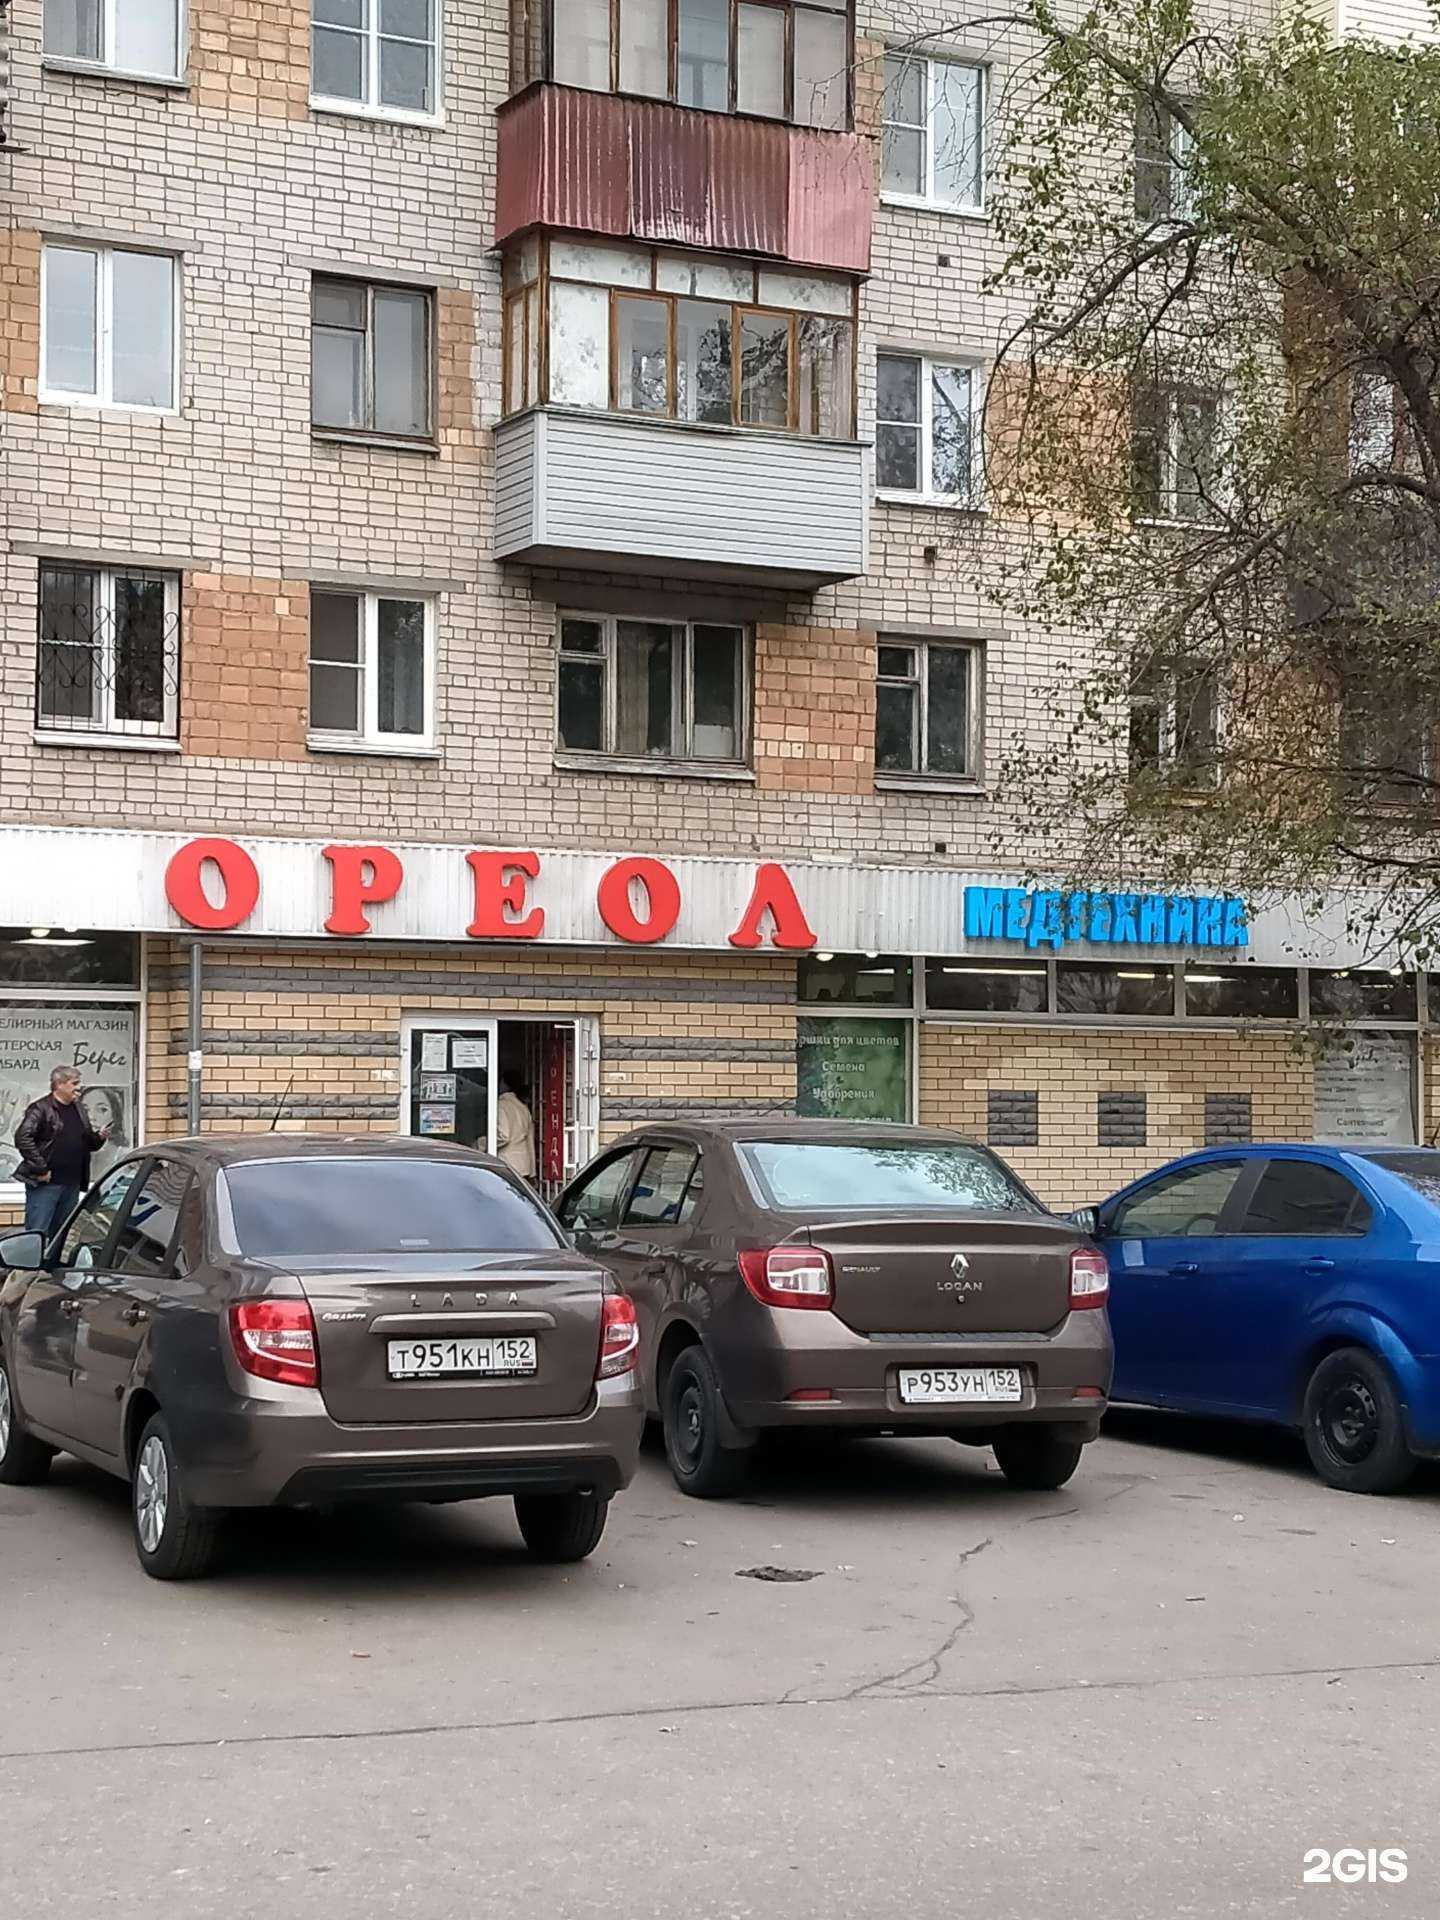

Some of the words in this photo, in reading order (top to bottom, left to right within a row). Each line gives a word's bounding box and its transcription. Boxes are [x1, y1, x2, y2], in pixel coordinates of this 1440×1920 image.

[165, 838, 818, 948] ОРЕОЛ
[964, 886, 1249, 949] МЕДТЕХНИКА
[67, 1020, 128, 1031] МАГАЗИН
[797, 1035, 831, 1049] ршки
[856, 1036, 900, 1047] цветов
[73, 1042, 127, 1074] Берег
[822, 1061, 866, 1072] Семена
[813, 1087, 875, 1102] Удобрения
[936, 1281, 983, 1291] LOGAN
[410, 1292, 519, 1307] LADA
[397, 1343, 490, 1369] Т951КН
[496, 1340, 530, 1359] 152
[503, 1359, 519, 1367] RUS
[907, 1371, 984, 1393] Р953УН
[989, 1370, 1016, 1387] 152
